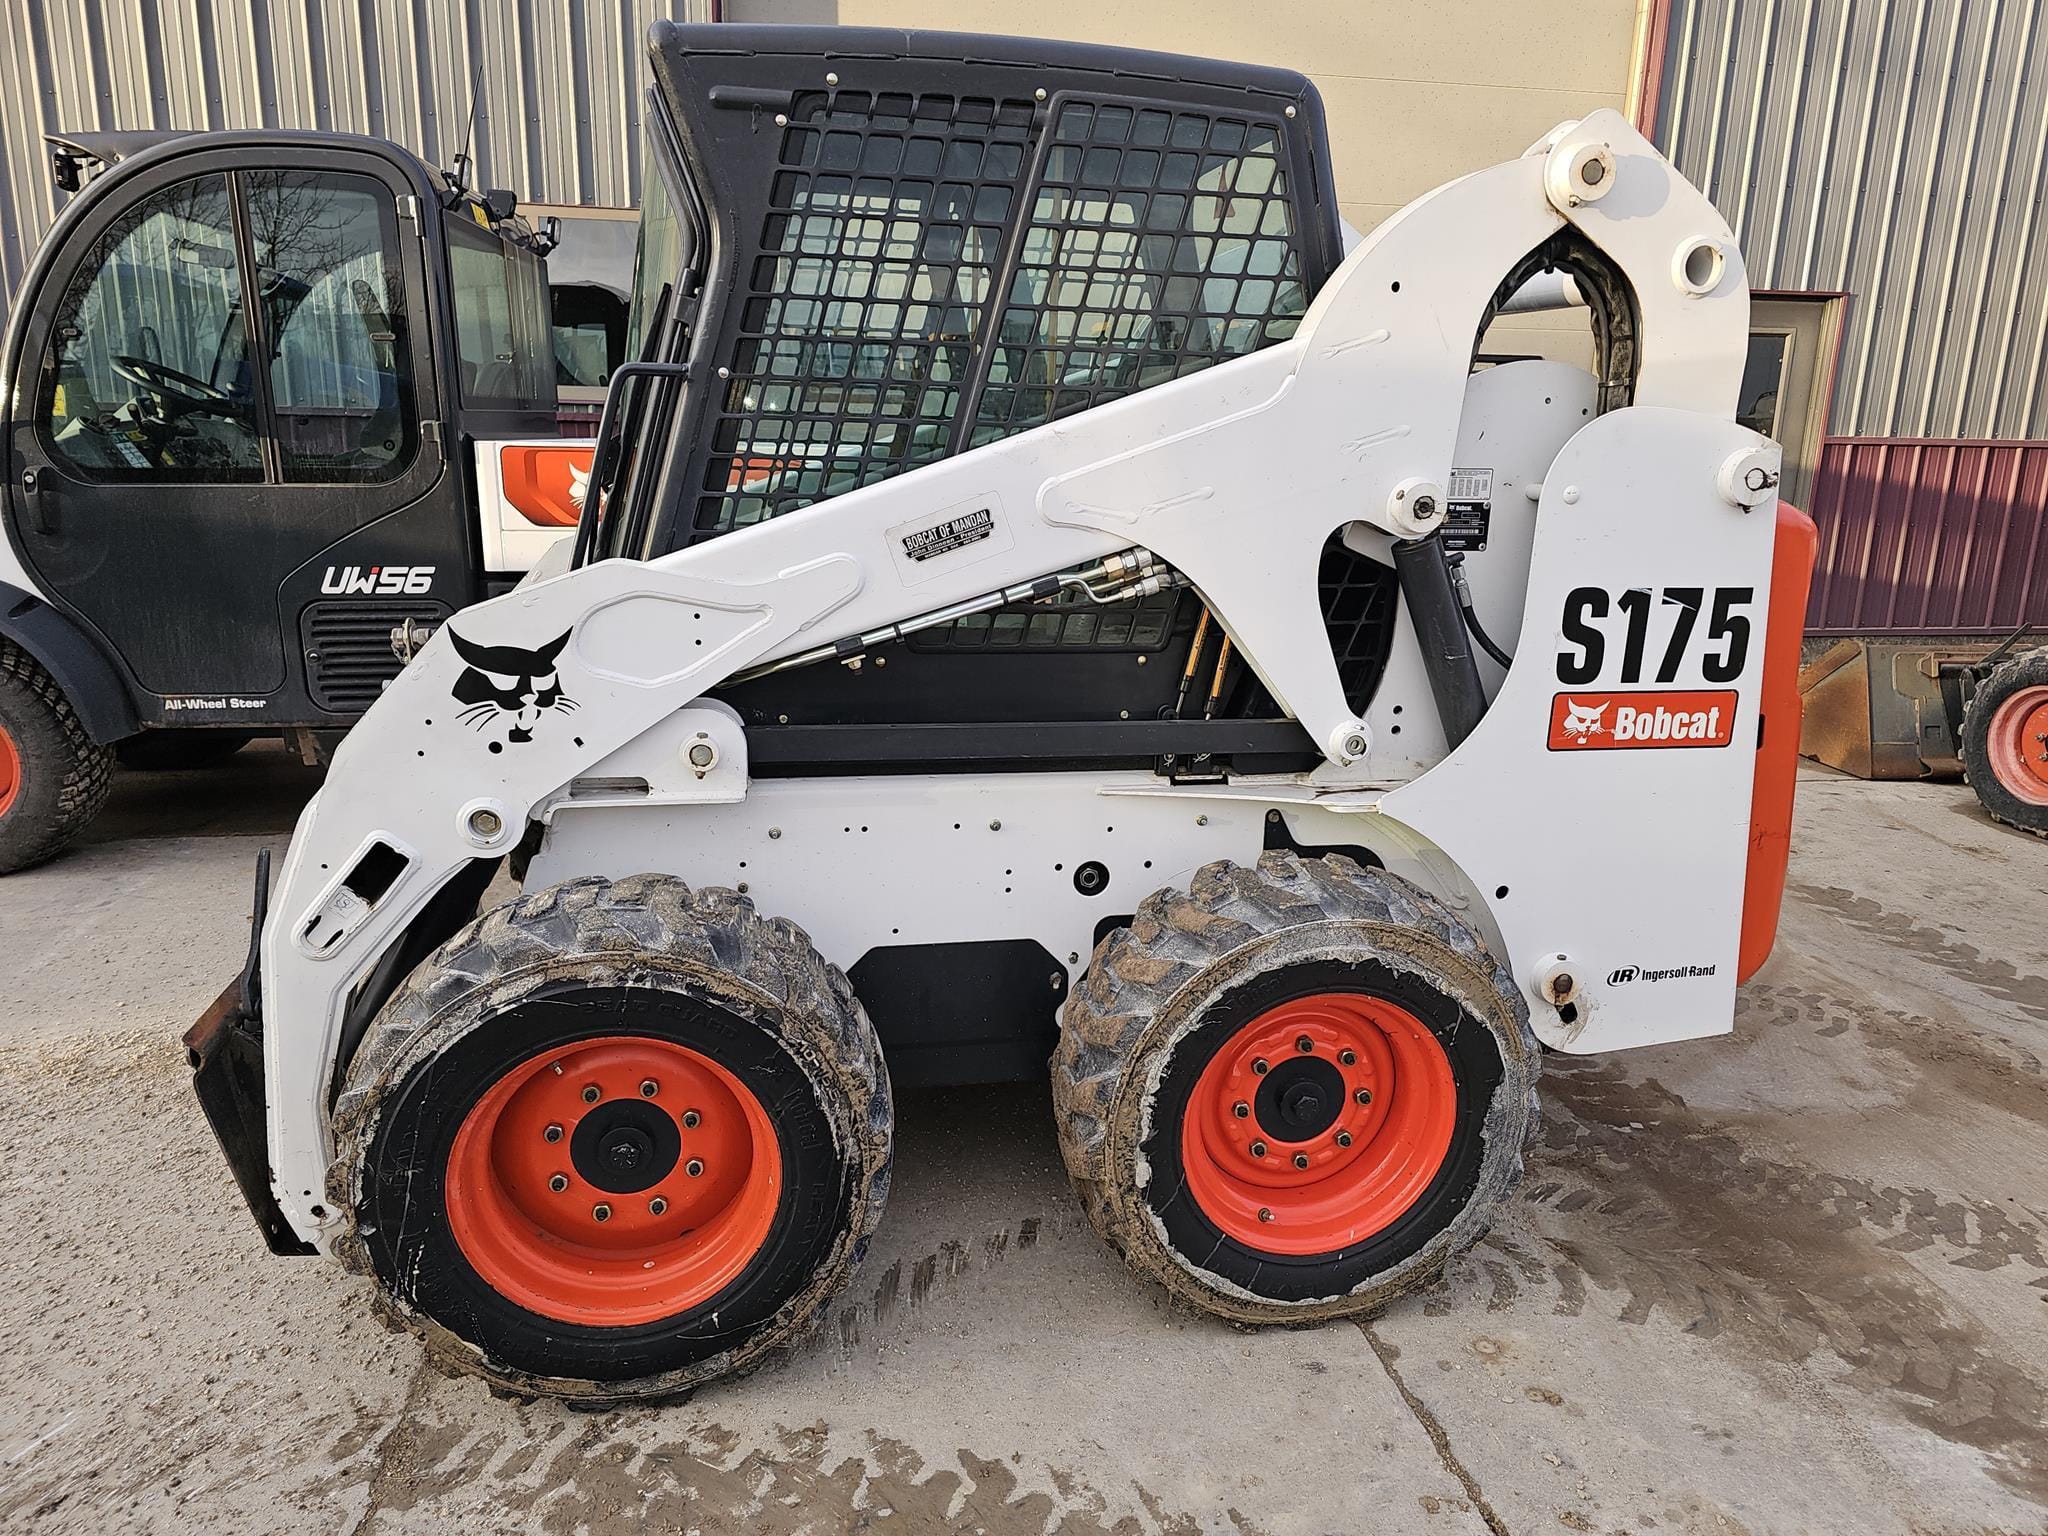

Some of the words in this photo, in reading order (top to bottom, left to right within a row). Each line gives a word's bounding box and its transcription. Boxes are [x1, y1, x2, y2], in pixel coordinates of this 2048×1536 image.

[905, 527, 939, 550] BOBCAT
[938, 522, 951, 538] OF
[951, 510, 989, 534] MANDAN
[960, 523, 992, 539] President
[1556, 586, 1754, 685] S175
[165, 698, 227, 710] All-Wheel
[229, 697, 267, 709] Steer
[1614, 706, 1721, 740] Bobcat
[1610, 967, 1637, 985] IR
